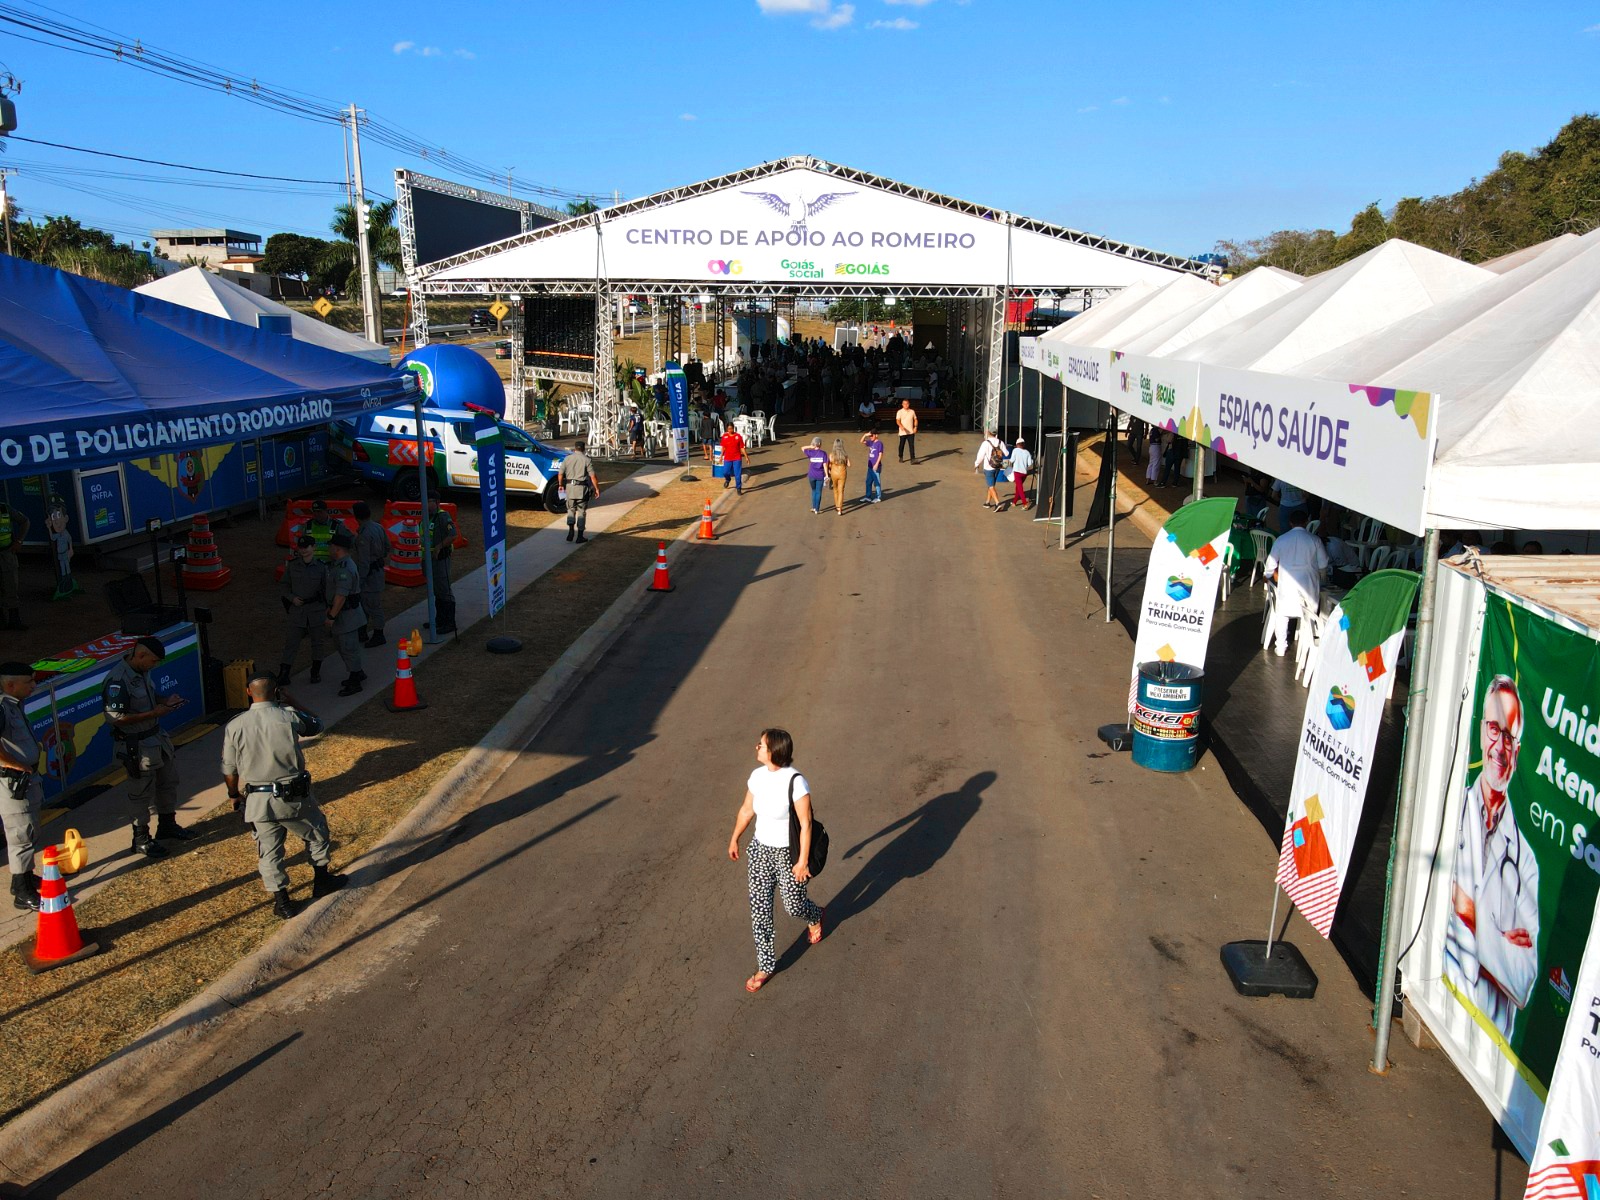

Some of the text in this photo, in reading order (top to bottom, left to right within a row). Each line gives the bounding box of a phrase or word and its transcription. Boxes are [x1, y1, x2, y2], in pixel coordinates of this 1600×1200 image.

[626, 228, 976, 249] CENTRO DE APOIO AO ROMEIRO
[781, 259, 815, 270] Goiás
[845, 262, 890, 275] GOIÁS
[789, 267, 824, 279] social
[29, 432, 70, 463] DE
[75, 412, 236, 456] POLICIAMENTO
[237, 397, 333, 433] RODOVIÁRIO
[1218, 393, 1350, 467] ESPAÇO SAÚDE
[505, 461, 530, 470] OLÍCIA
[505, 469, 529, 477] ILITAR
[90, 484, 102, 492] GO
[488, 452, 499, 537] POLÍCIA
[91, 490, 113, 502] INFRA
[1148, 601, 1205, 615] PREFEITURA
[1147, 607, 1204, 626] TRINDADE
[159, 675, 170, 685] GO
[160, 680, 178, 692] INFRA
[1136, 708, 1183, 724] ACHEI
[1307, 718, 1364, 765] PREFEITURA
[1305, 728, 1362, 781] TRINDADE
[1530, 801, 1565, 847] em
